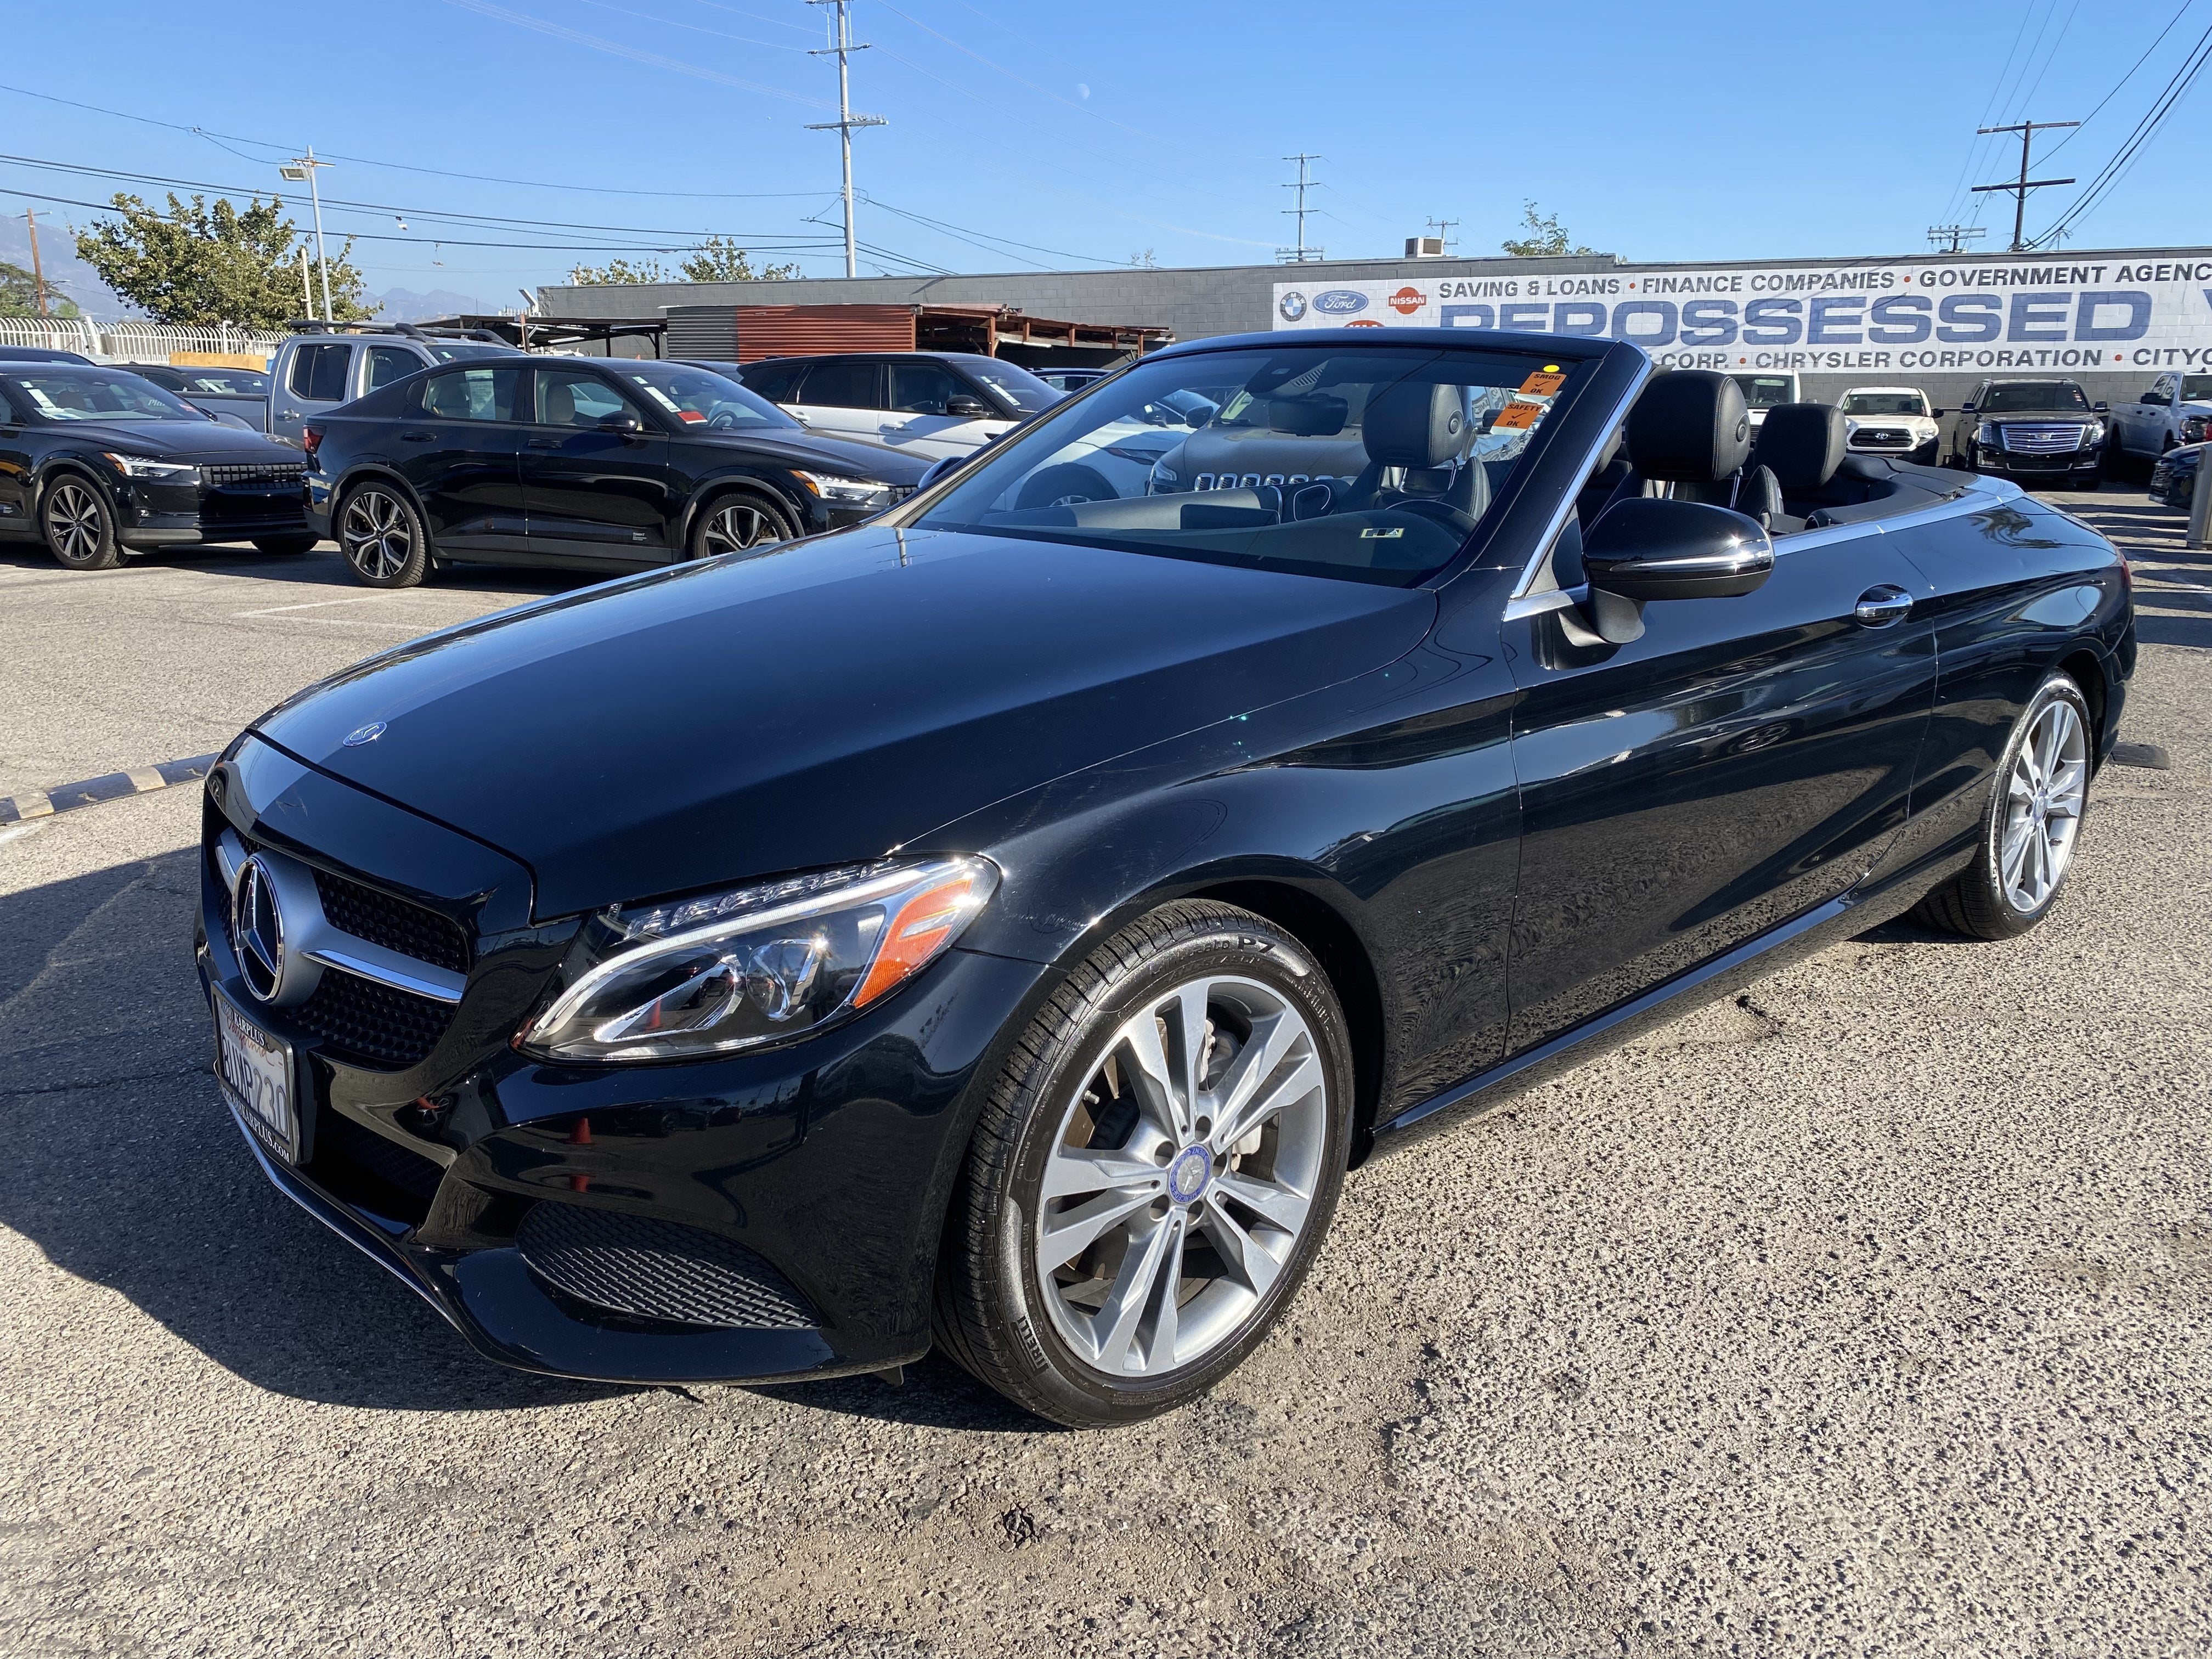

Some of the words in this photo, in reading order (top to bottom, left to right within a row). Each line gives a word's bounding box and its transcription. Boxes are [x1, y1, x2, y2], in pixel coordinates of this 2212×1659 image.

[1439, 281, 1519, 298] SAVING
[1528, 280, 1539, 296] &
[1547, 279, 1620, 296] LOANS
[1643, 276, 1742, 293] FINANCE
[1751, 272, 1895, 291] COMPANIES
[1920, 266, 2108, 287] GOVERNMENT
[1280, 292, 1306, 305] BMW
[1324, 295, 1356, 311] Ford
[1390, 296, 1426, 306] NISSAN
[1756, 351, 1892, 369] CHRYSLER
[1899, 349, 2102, 368] CORPORATION
[1238, 936, 1276, 954] P7
[234, 1012, 265, 1046] KARPLUS
[1171, 1184, 1197, 1202] MERCEDES
